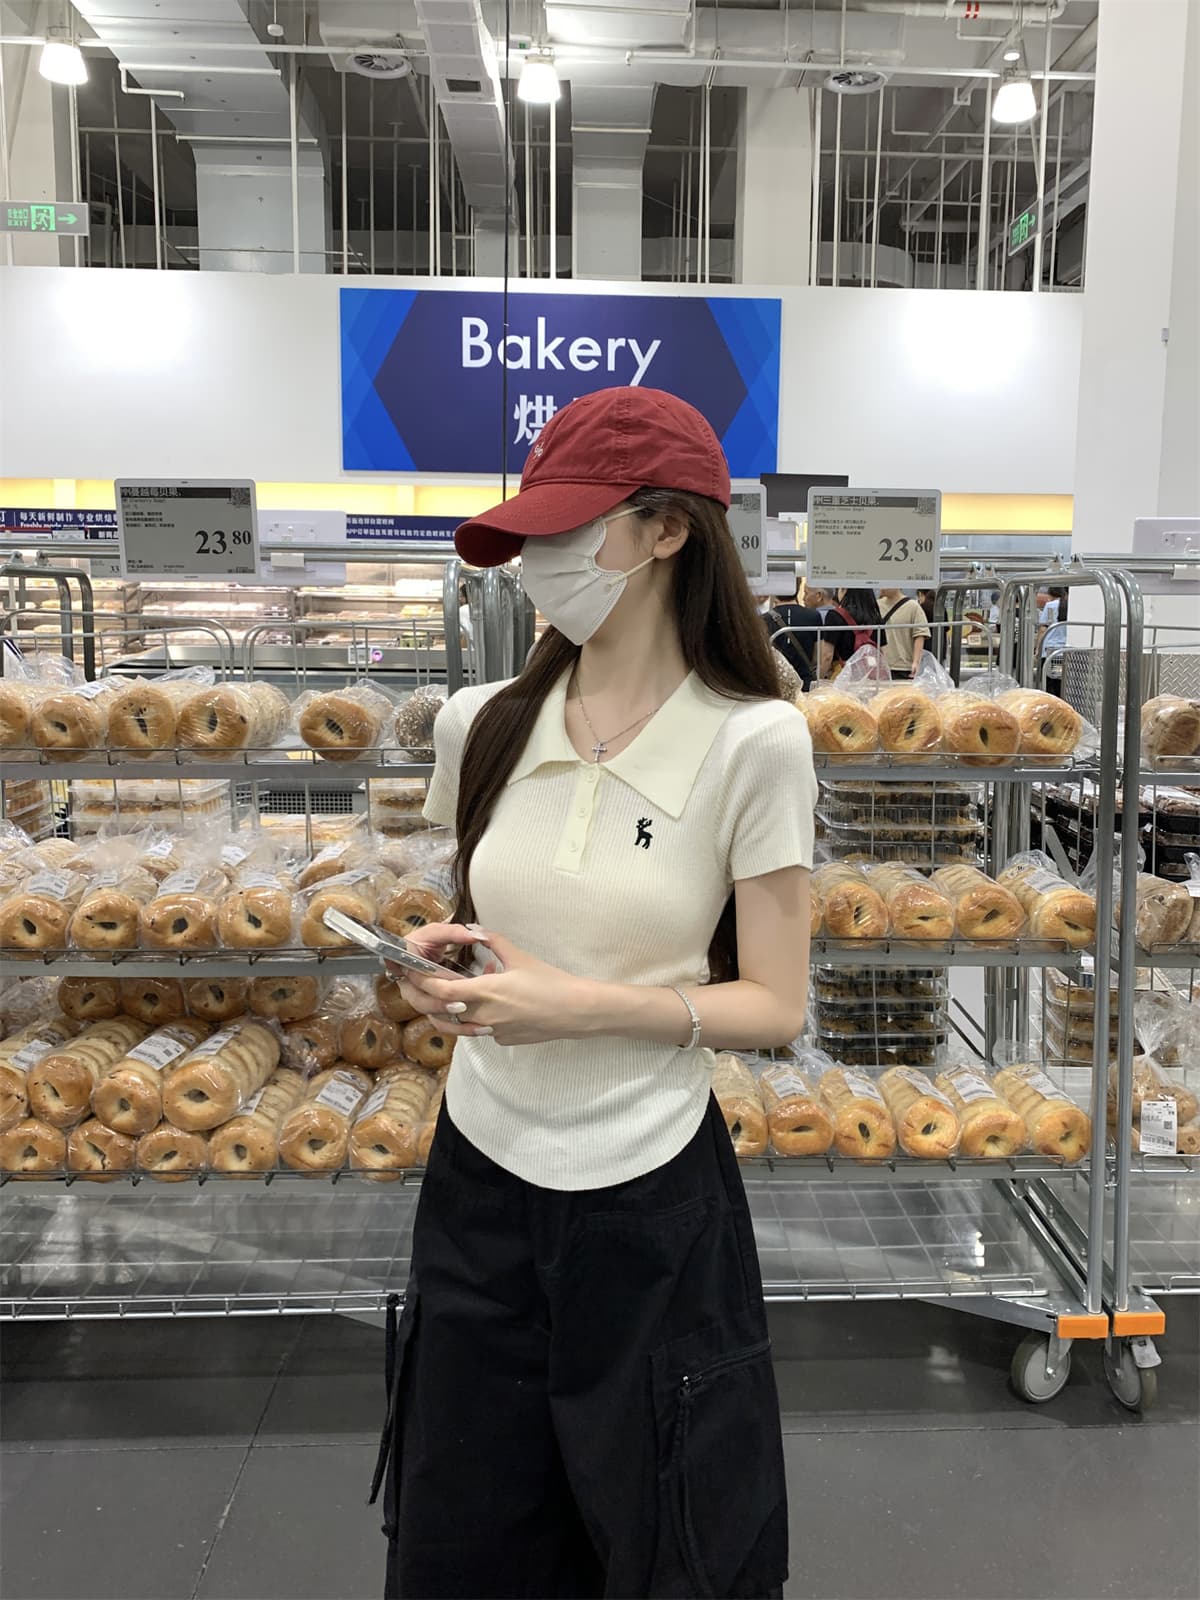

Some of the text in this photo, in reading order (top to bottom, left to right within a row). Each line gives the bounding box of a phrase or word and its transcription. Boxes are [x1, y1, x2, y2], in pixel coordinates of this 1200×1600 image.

[461, 316, 662, 387] Bakery
[513, 395, 578, 446] 烘
[195, 530, 251, 554] 23.80
[878, 538, 933, 562] 23.80
